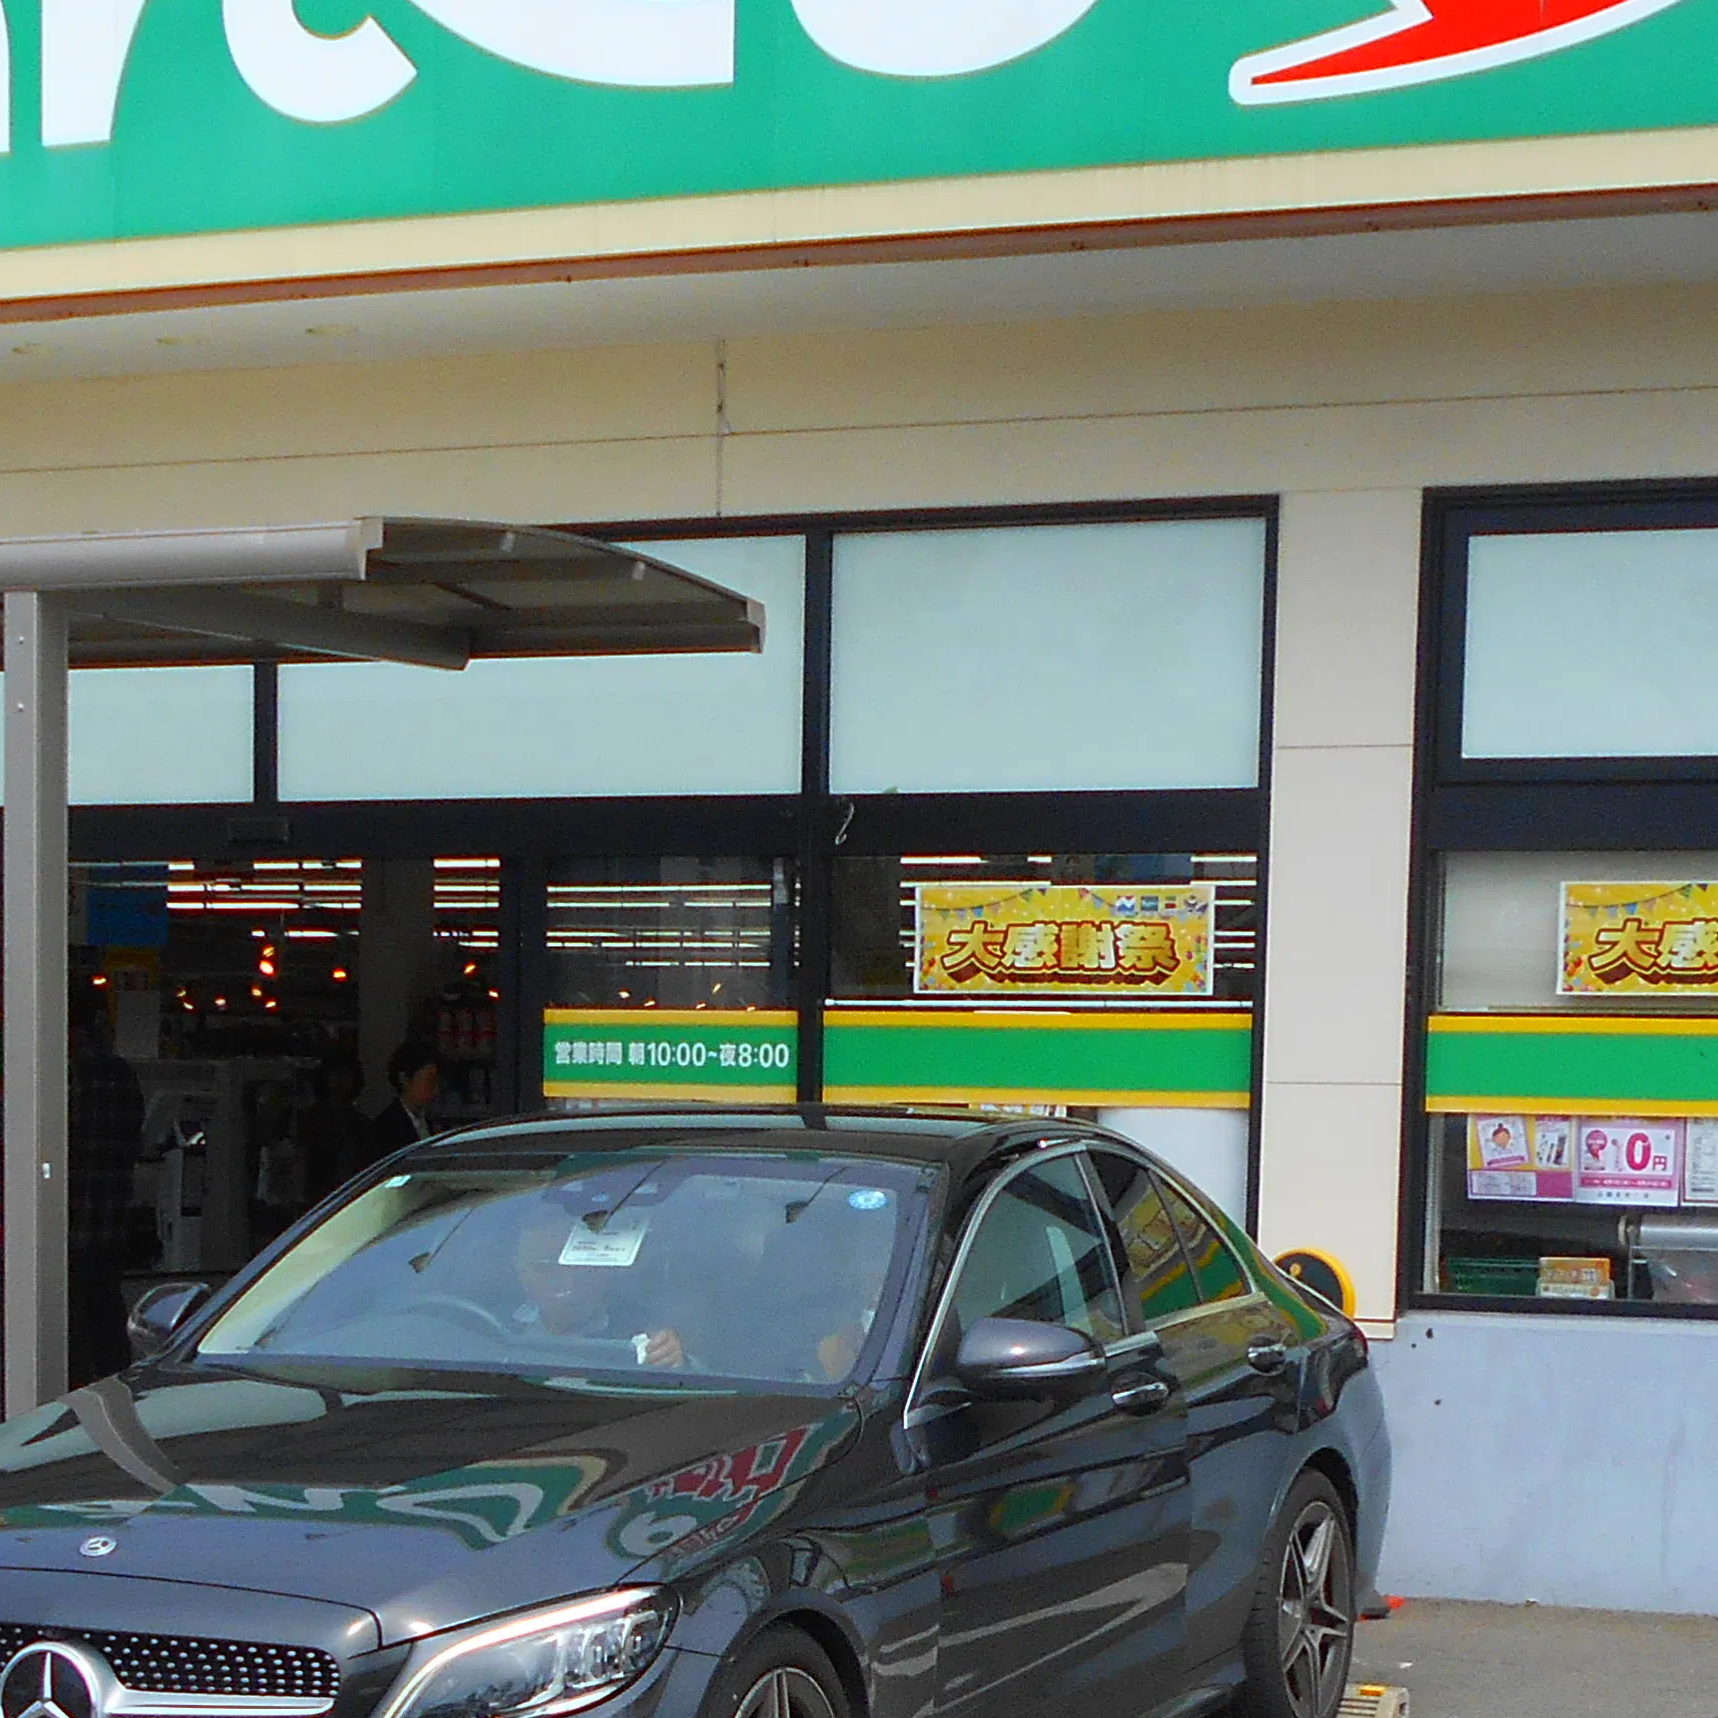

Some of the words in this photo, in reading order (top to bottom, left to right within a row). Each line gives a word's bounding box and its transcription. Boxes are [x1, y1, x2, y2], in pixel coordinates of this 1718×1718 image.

[941, 921, 1180, 974] 大感謝祭
[555, 1042, 622, 1064] 営業時間
